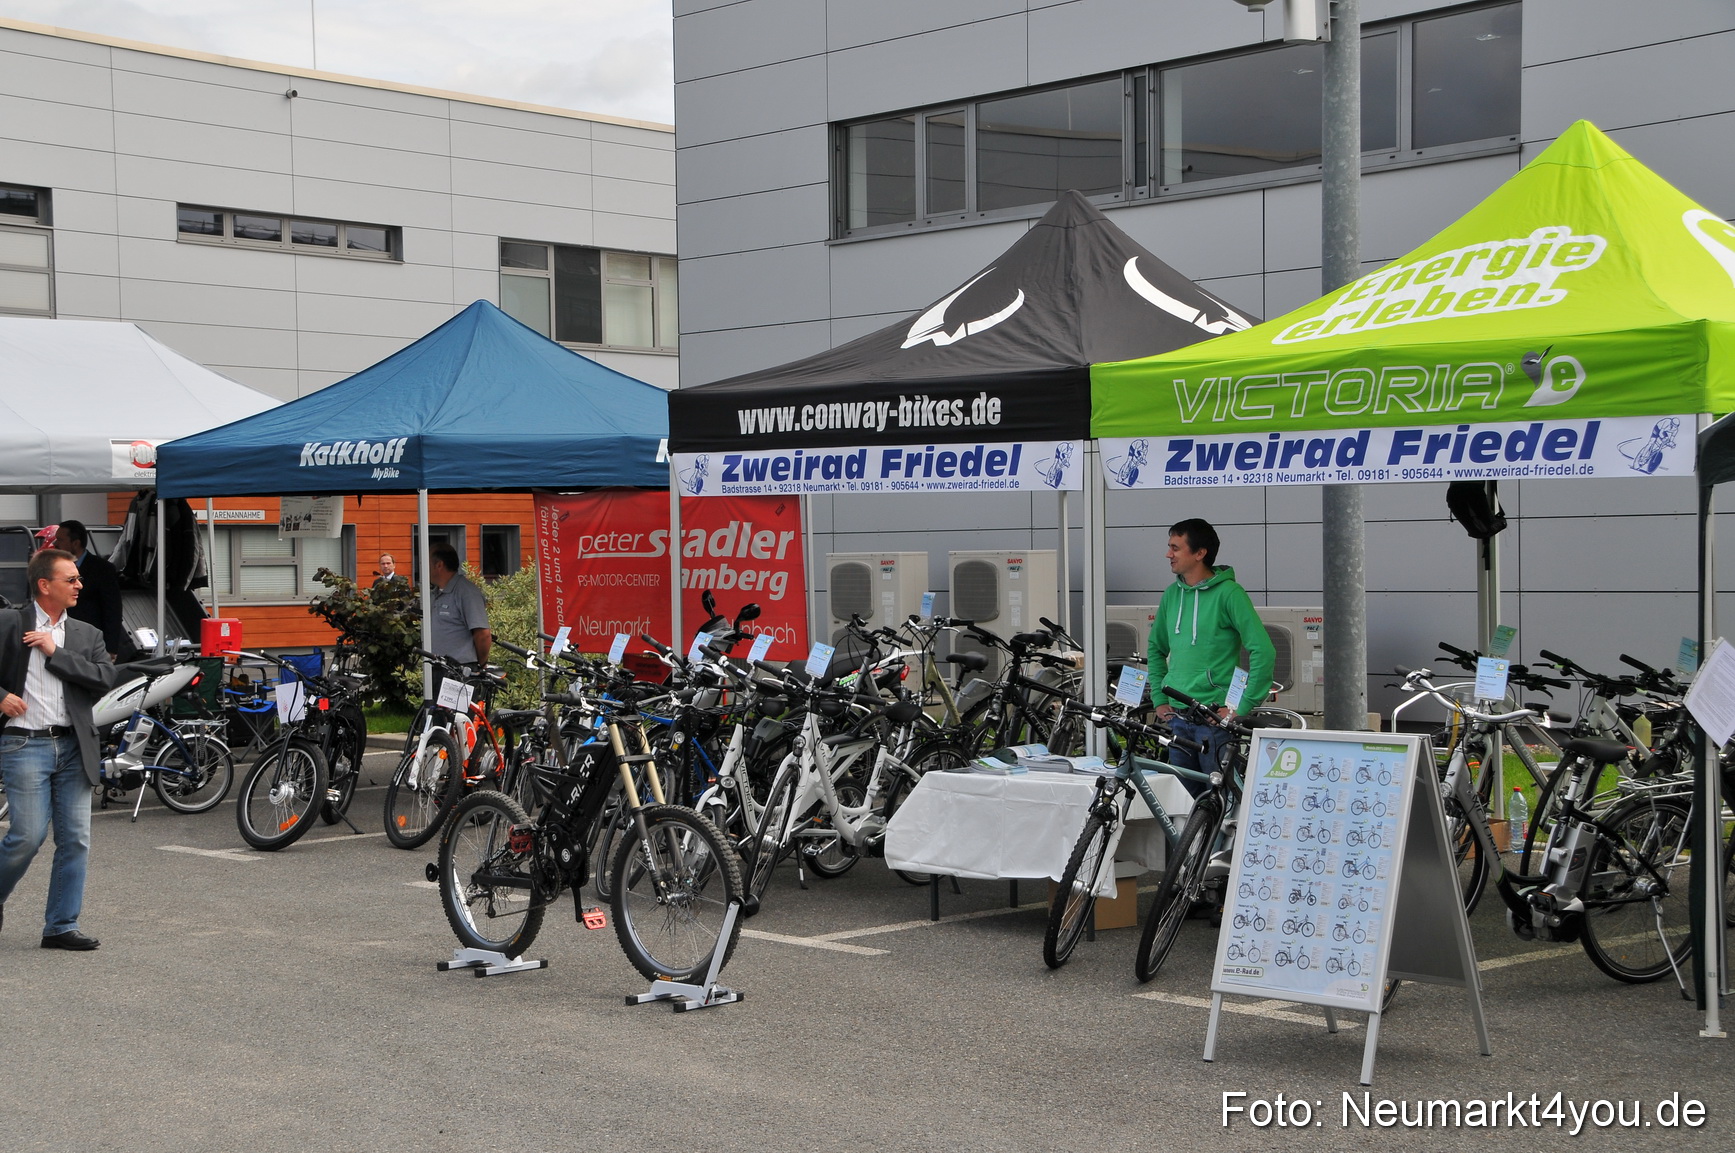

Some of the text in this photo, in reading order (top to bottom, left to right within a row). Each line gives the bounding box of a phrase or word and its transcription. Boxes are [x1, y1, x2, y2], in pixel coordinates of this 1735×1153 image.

[1352, 232, 1602, 299] Energie
[1286, 279, 1553, 337] erleben.
[737, 391, 1002, 435] www.conway-bikes.de
[299, 437, 409, 467] Kalkhoff
[1165, 420, 1601, 473] Zweirad Friedel
[371, 467, 400, 481] MyBike
[721, 444, 1023, 483] Zweirad Friedel
[1164, 474, 1219, 486] Badstrasse
[1222, 474, 1234, 485] 14
[1242, 473, 1273, 484] 92318
[1276, 471, 1326, 483] Neumarkt
[1336, 470, 1354, 481] Tel.
[1357, 470, 1391, 481] 09181
[1401, 467, 1443, 480] 905644
[1454, 463, 1594, 478] www.zweirad-friedel.de
[721, 482, 762, 494] Badstrasse
[763, 482, 773, 493] 14
[779, 481, 801, 493] 92318
[802, 480, 841, 492] Neumarkt
[846, 480, 859, 491] Tel.
[860, 479, 883, 491] 09181
[890, 479, 919, 491] 905644
[926, 478, 1020, 491] www.zweirad-friedel.de
[551, 505, 560, 543] Jeder
[540, 505, 553, 584] fährt gut mit
[552, 545, 561, 554] 2
[577, 530, 644, 559] peter
[553, 557, 563, 583] und
[577, 573, 661, 587] PS-MOTOR-CENTER
[556, 585, 563, 594] 4
[578, 615, 651, 637] Neumarkt
[1025, 706, 1050, 739] VICTOR
[740, 761, 754, 812] VICTORIA
[1140, 780, 1177, 836] VICTORIA
[1472, 794, 1502, 862] VICTORIA
